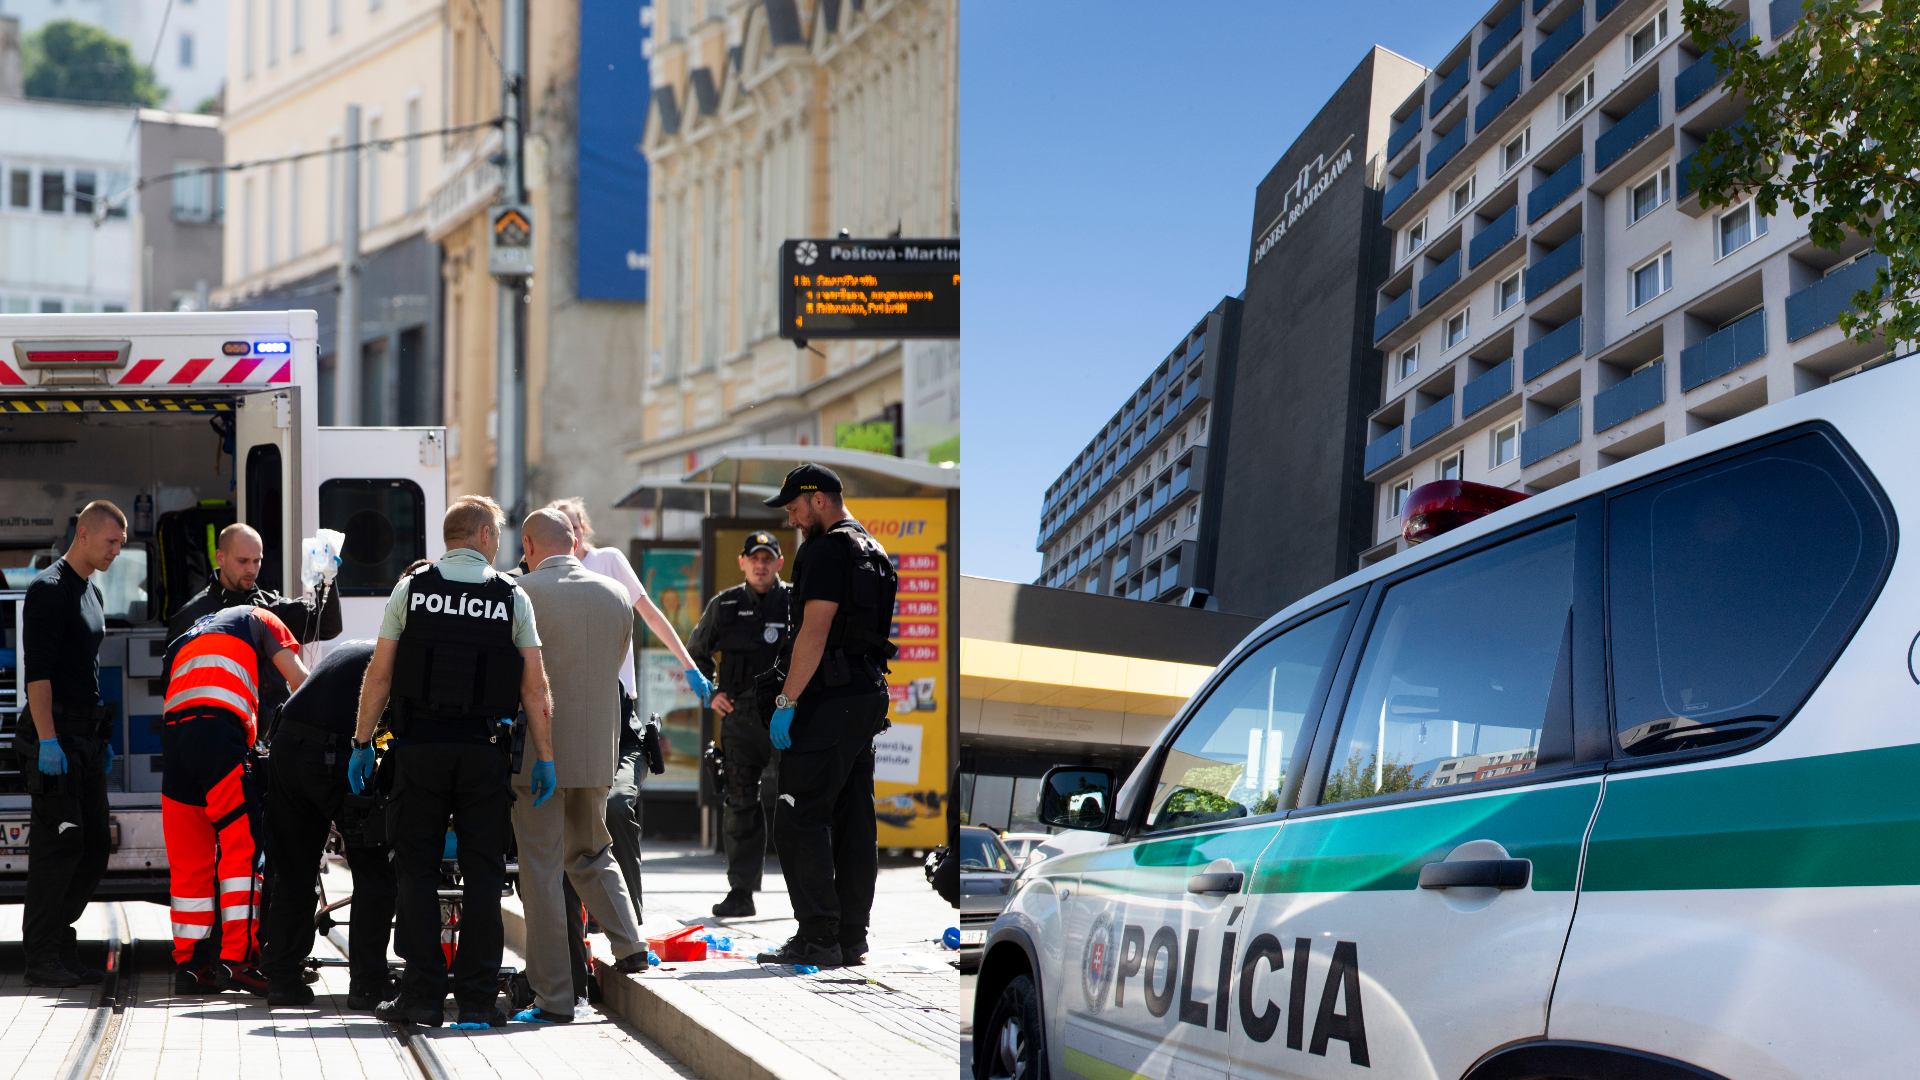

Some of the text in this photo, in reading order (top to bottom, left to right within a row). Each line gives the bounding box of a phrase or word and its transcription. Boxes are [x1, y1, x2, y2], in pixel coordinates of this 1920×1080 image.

[1254, 149, 1353, 264] HOTEL BRATISLAVA
[830, 246, 960, 261] Poštová-Martin
[410, 593, 508, 621] POLÍCIA
[1114, 906, 1371, 1068] POLÍCIA
